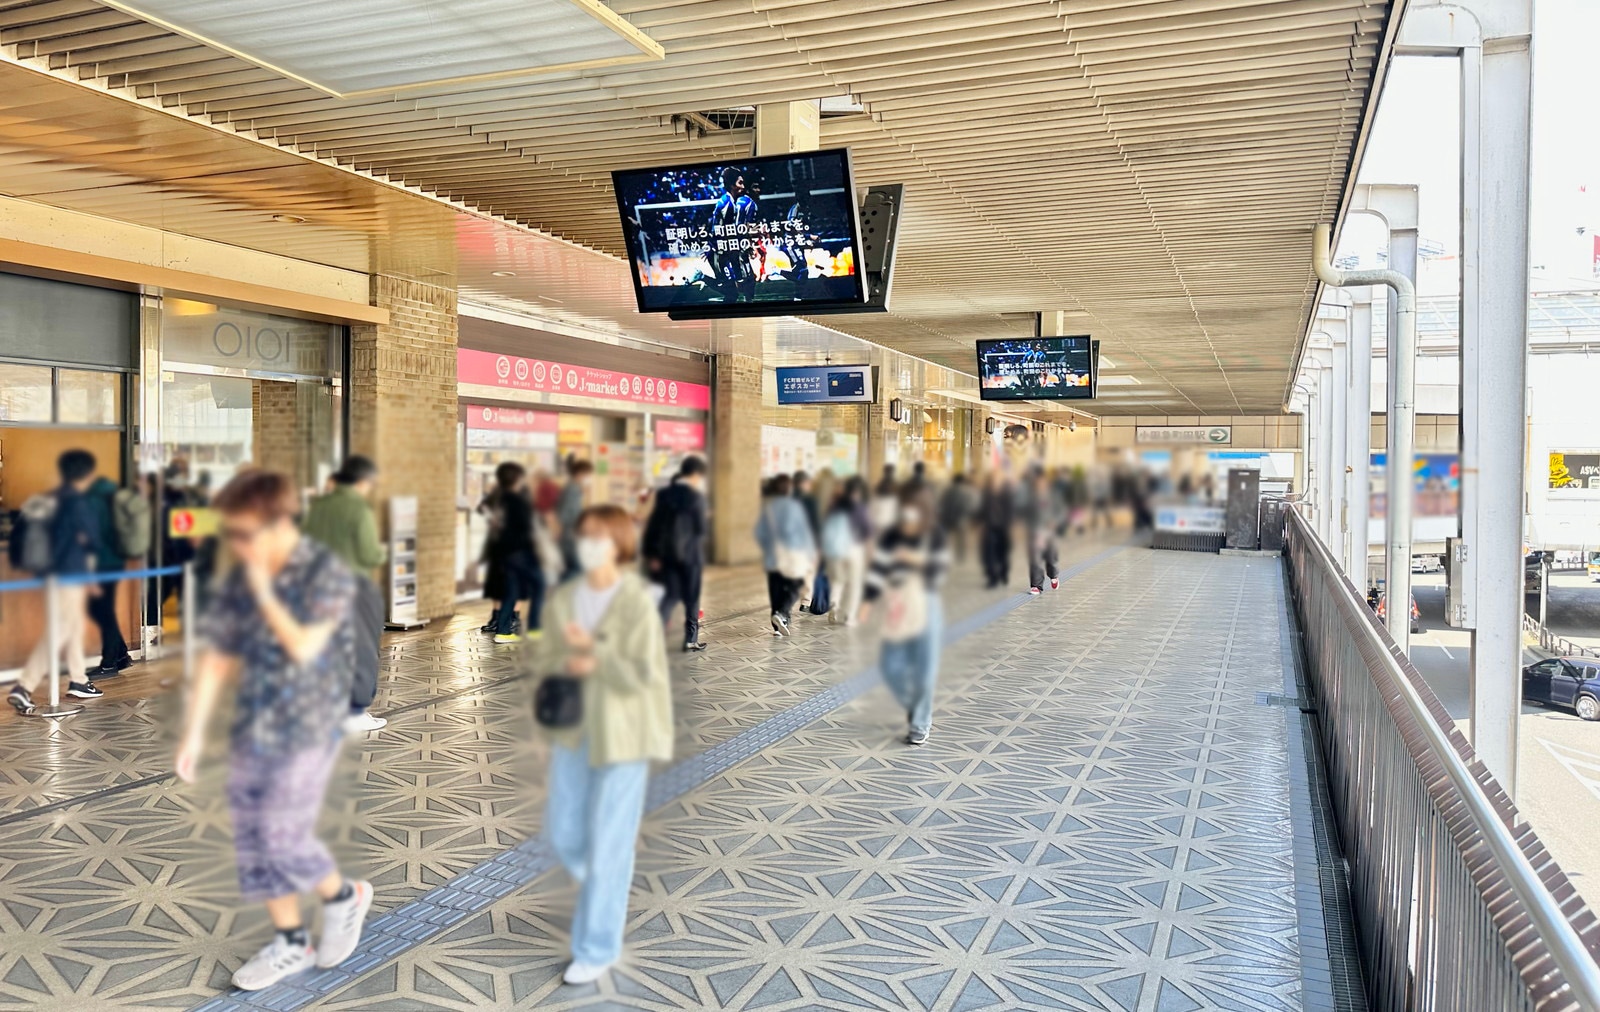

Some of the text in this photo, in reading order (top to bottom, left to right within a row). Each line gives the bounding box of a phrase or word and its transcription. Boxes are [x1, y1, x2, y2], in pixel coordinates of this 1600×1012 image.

[665, 219, 810, 240] 証明しろ、町田のこれまでを。
